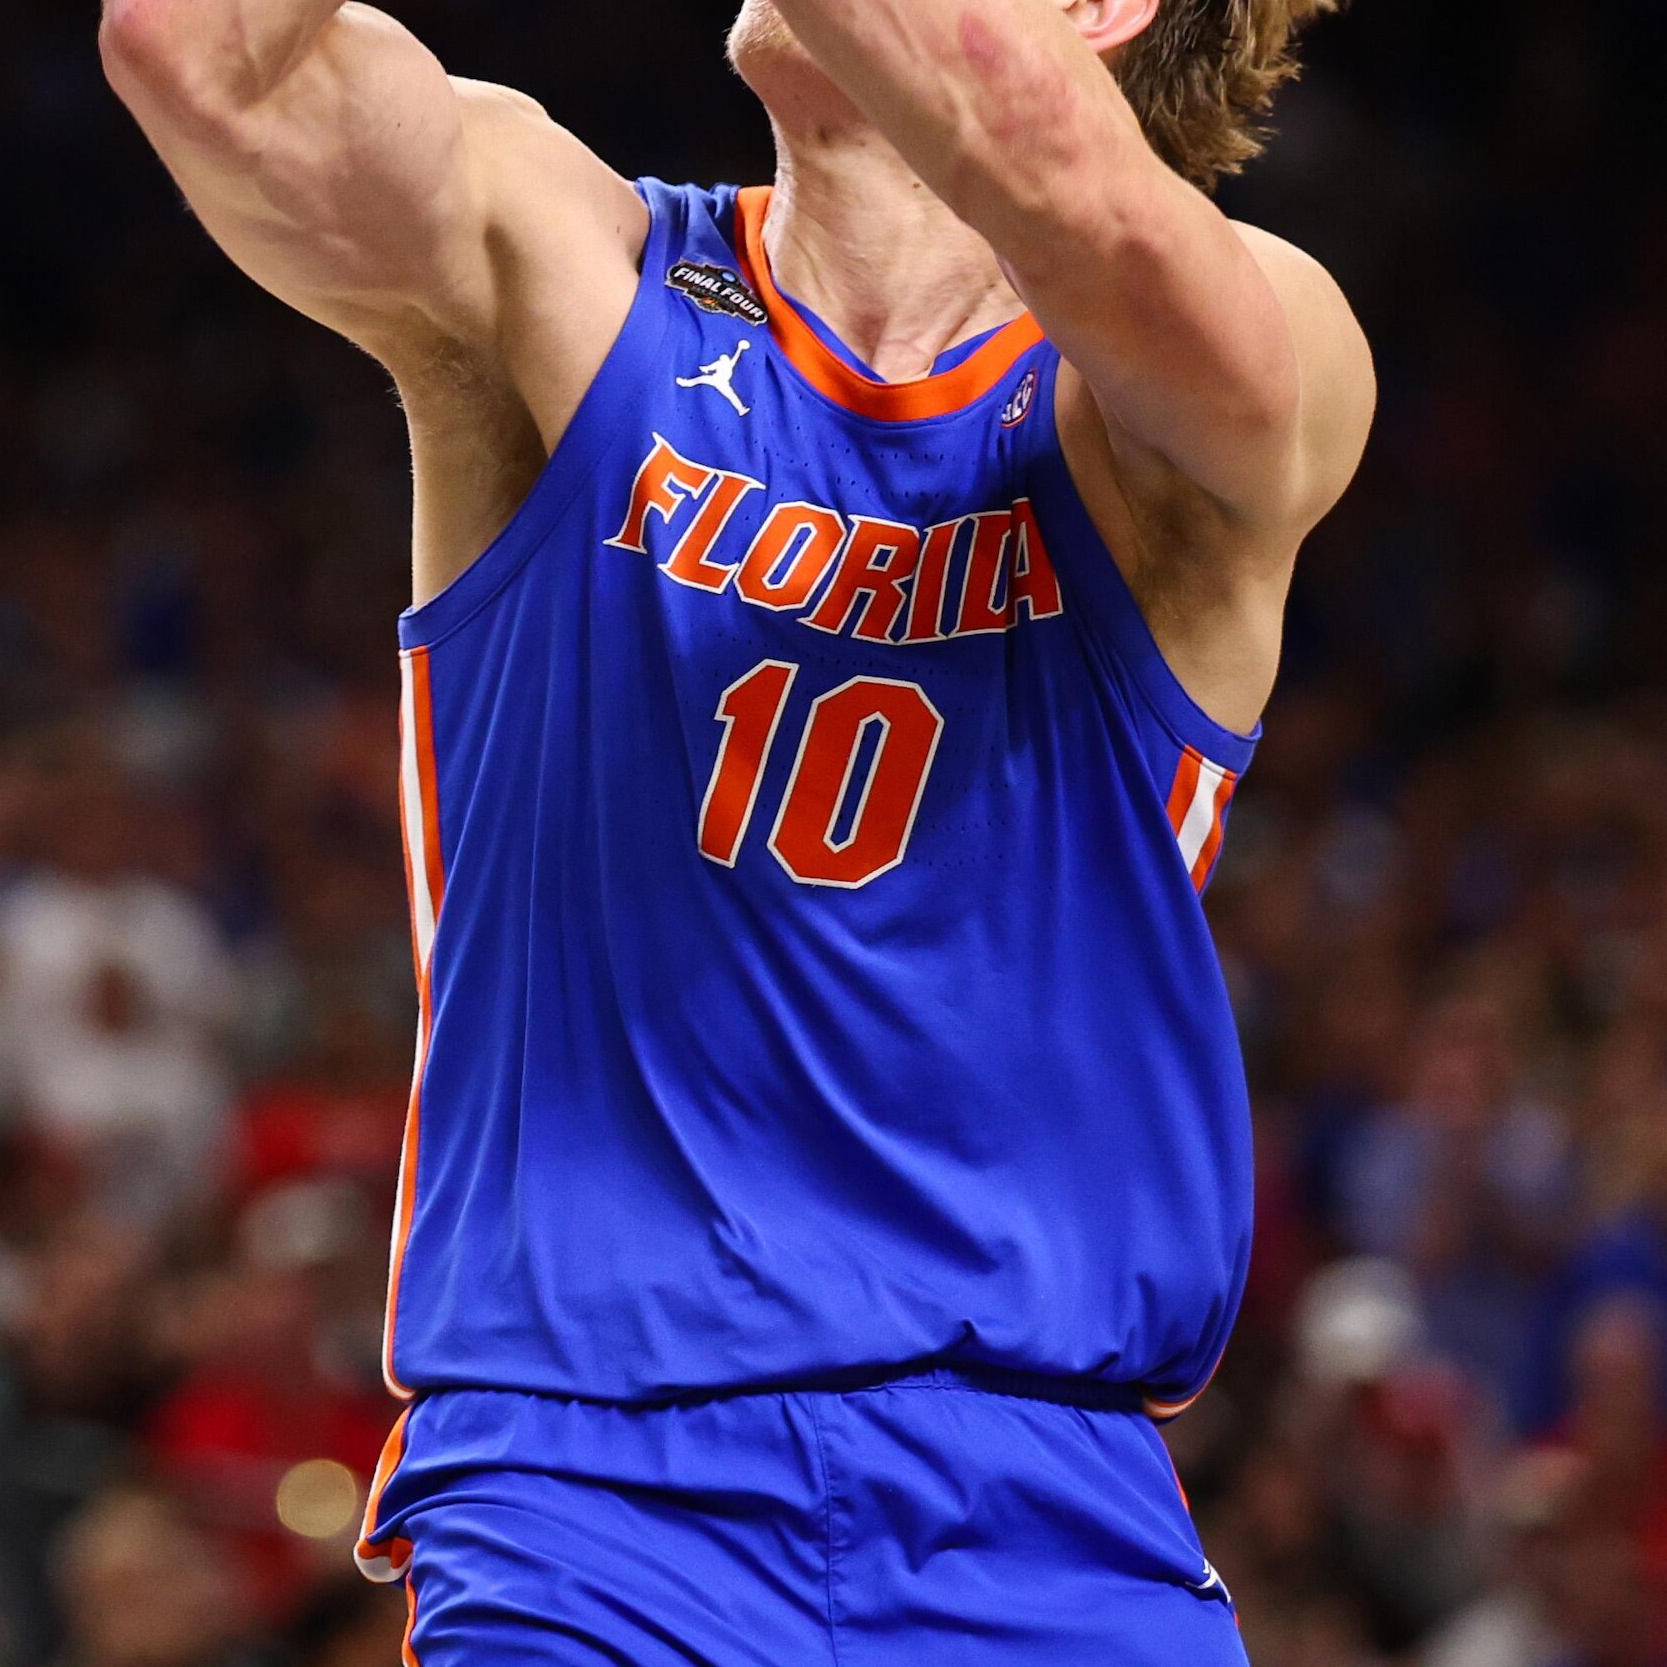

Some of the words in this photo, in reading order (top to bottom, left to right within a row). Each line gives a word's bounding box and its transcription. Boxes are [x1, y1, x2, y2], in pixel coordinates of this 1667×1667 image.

[673, 267, 722, 293] FINAL
[720, 287, 764, 318] FOUR
[697, 658, 945, 890] 10
